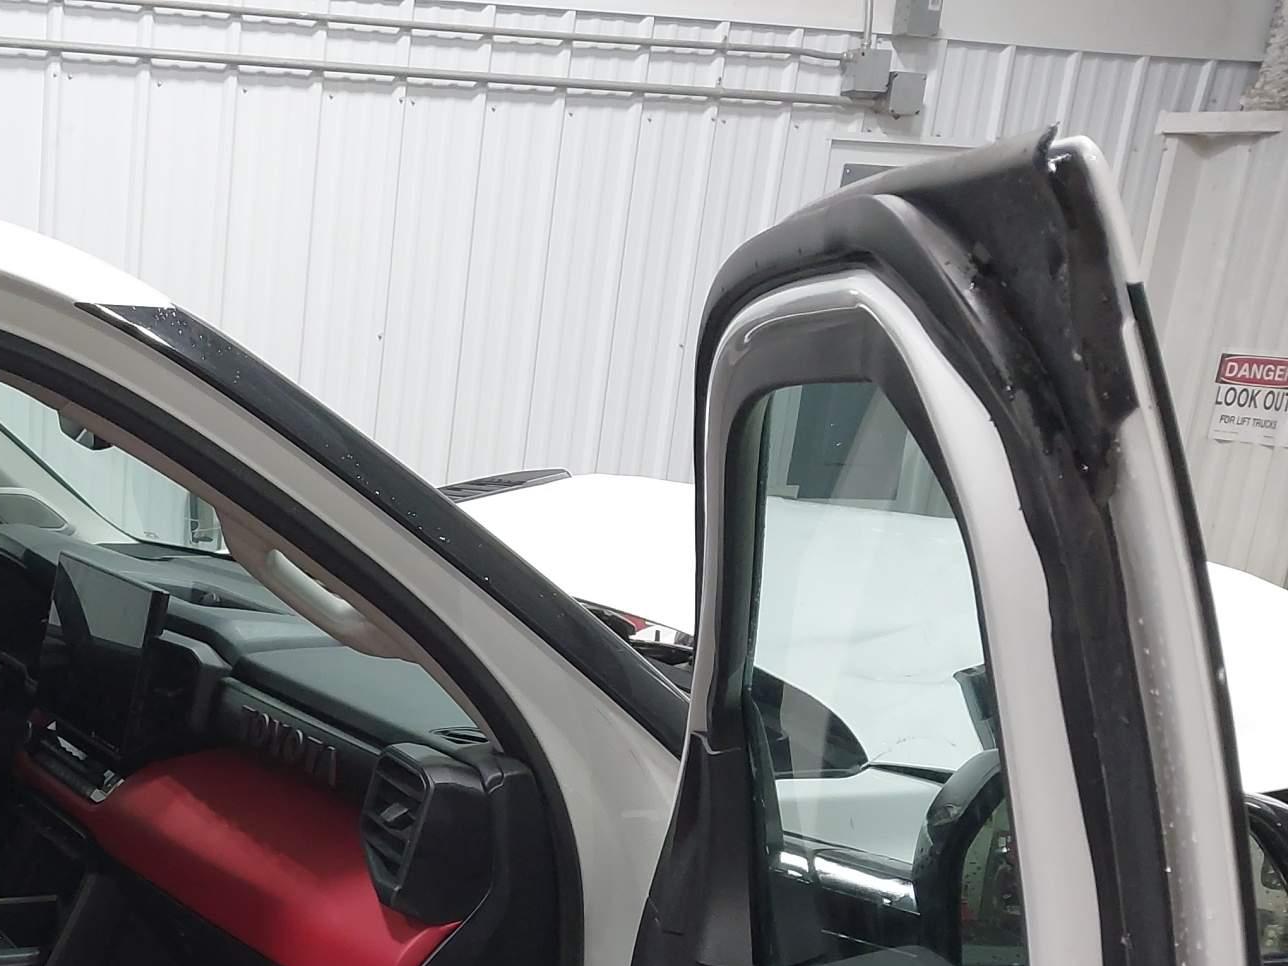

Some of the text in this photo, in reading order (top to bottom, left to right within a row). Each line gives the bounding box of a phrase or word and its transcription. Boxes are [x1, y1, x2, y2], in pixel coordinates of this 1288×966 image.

[1215, 386, 1261, 408] LOOK
[1219, 414, 1278, 429] FOR LIFT TRUCKS
[241, 704, 337, 787] TOYOTA
